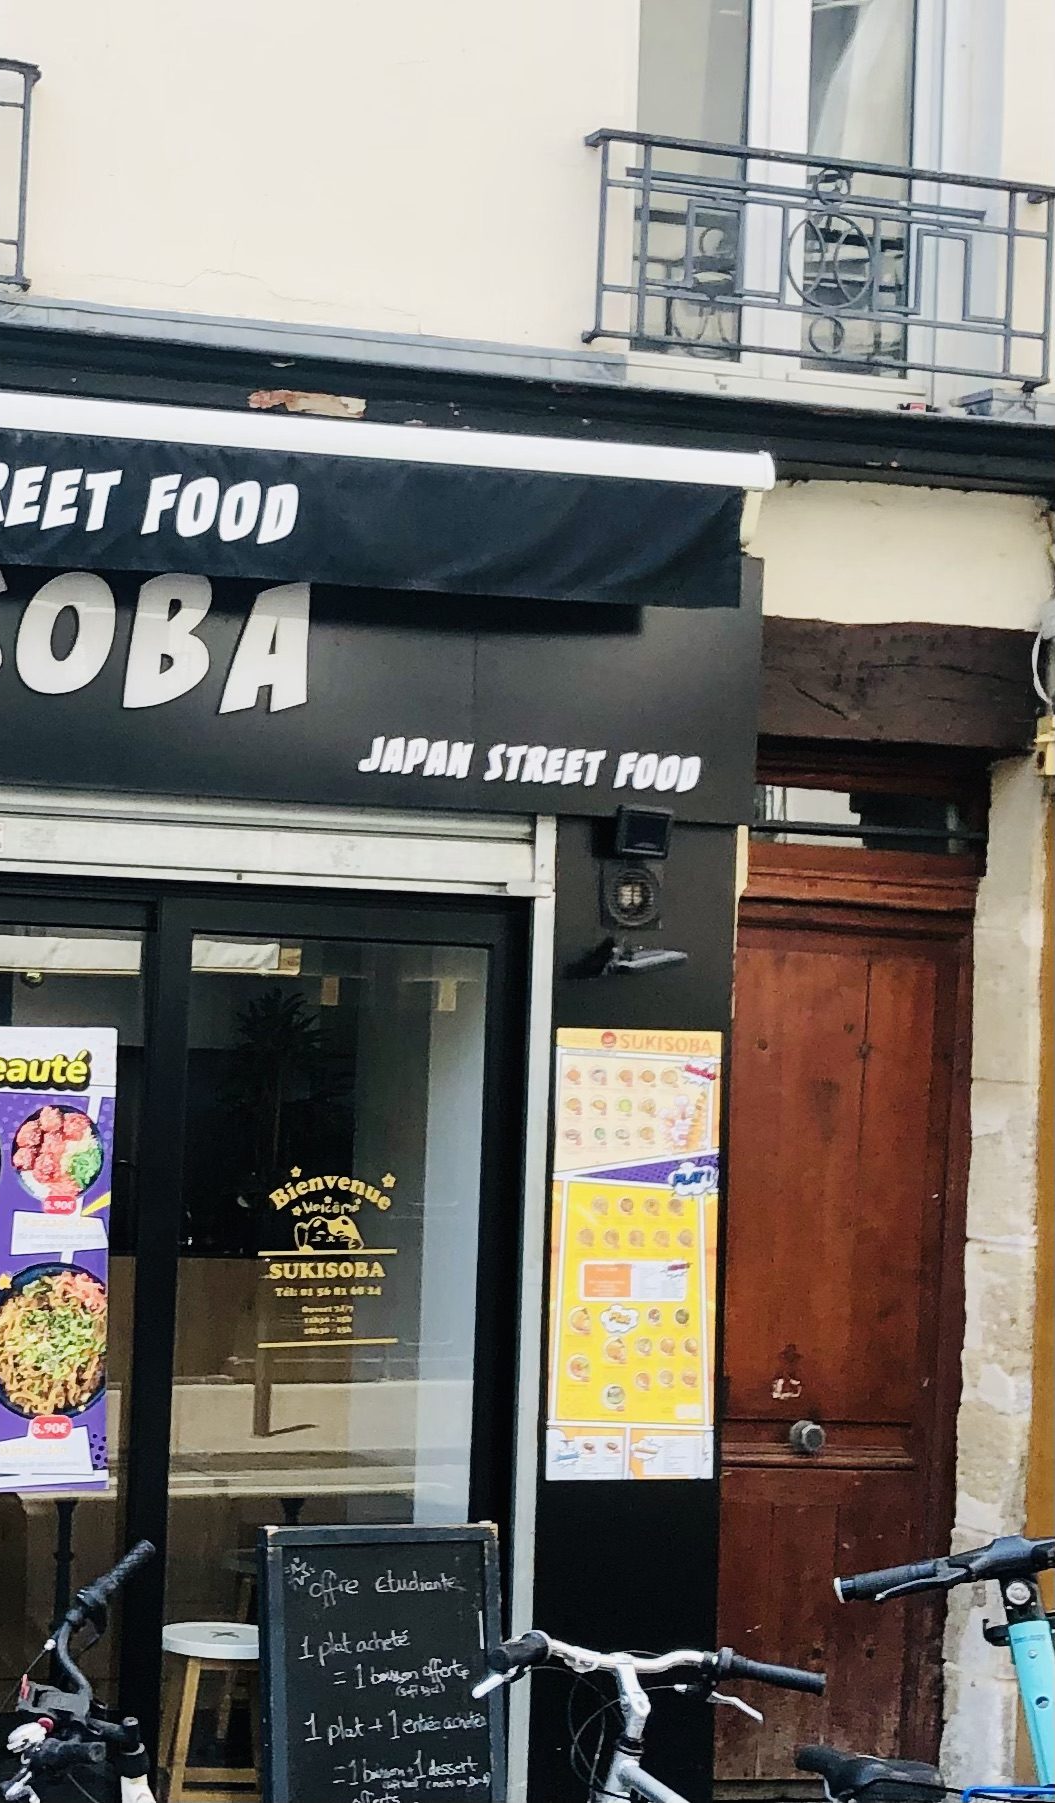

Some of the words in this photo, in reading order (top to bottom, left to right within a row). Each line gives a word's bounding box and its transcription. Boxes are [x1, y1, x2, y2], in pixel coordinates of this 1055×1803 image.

[140, 473, 299, 545] FOOD
[358, 736, 475, 779] JAPAN
[483, 743, 607, 787] STREET
[613, 751, 701, 792] FOOD
[619, 1033, 713, 1054] SUKISOBA
[268, 1175, 392, 1210] Bienvenue
[269, 1261, 386, 1279] SUKISOBA
[298, 1635, 315, 1660] 1
[319, 1631, 353, 1667] plat
[356, 1629, 411, 1653] acheté
[354, 1663, 366, 1689] 1
[303, 1712, 323, 1742] 1
[328, 1715, 365, 1746] plat
[387, 1709, 401, 1740] 1
[348, 1759, 359, 1786] 1
[428, 1755, 479, 1777] dessert
